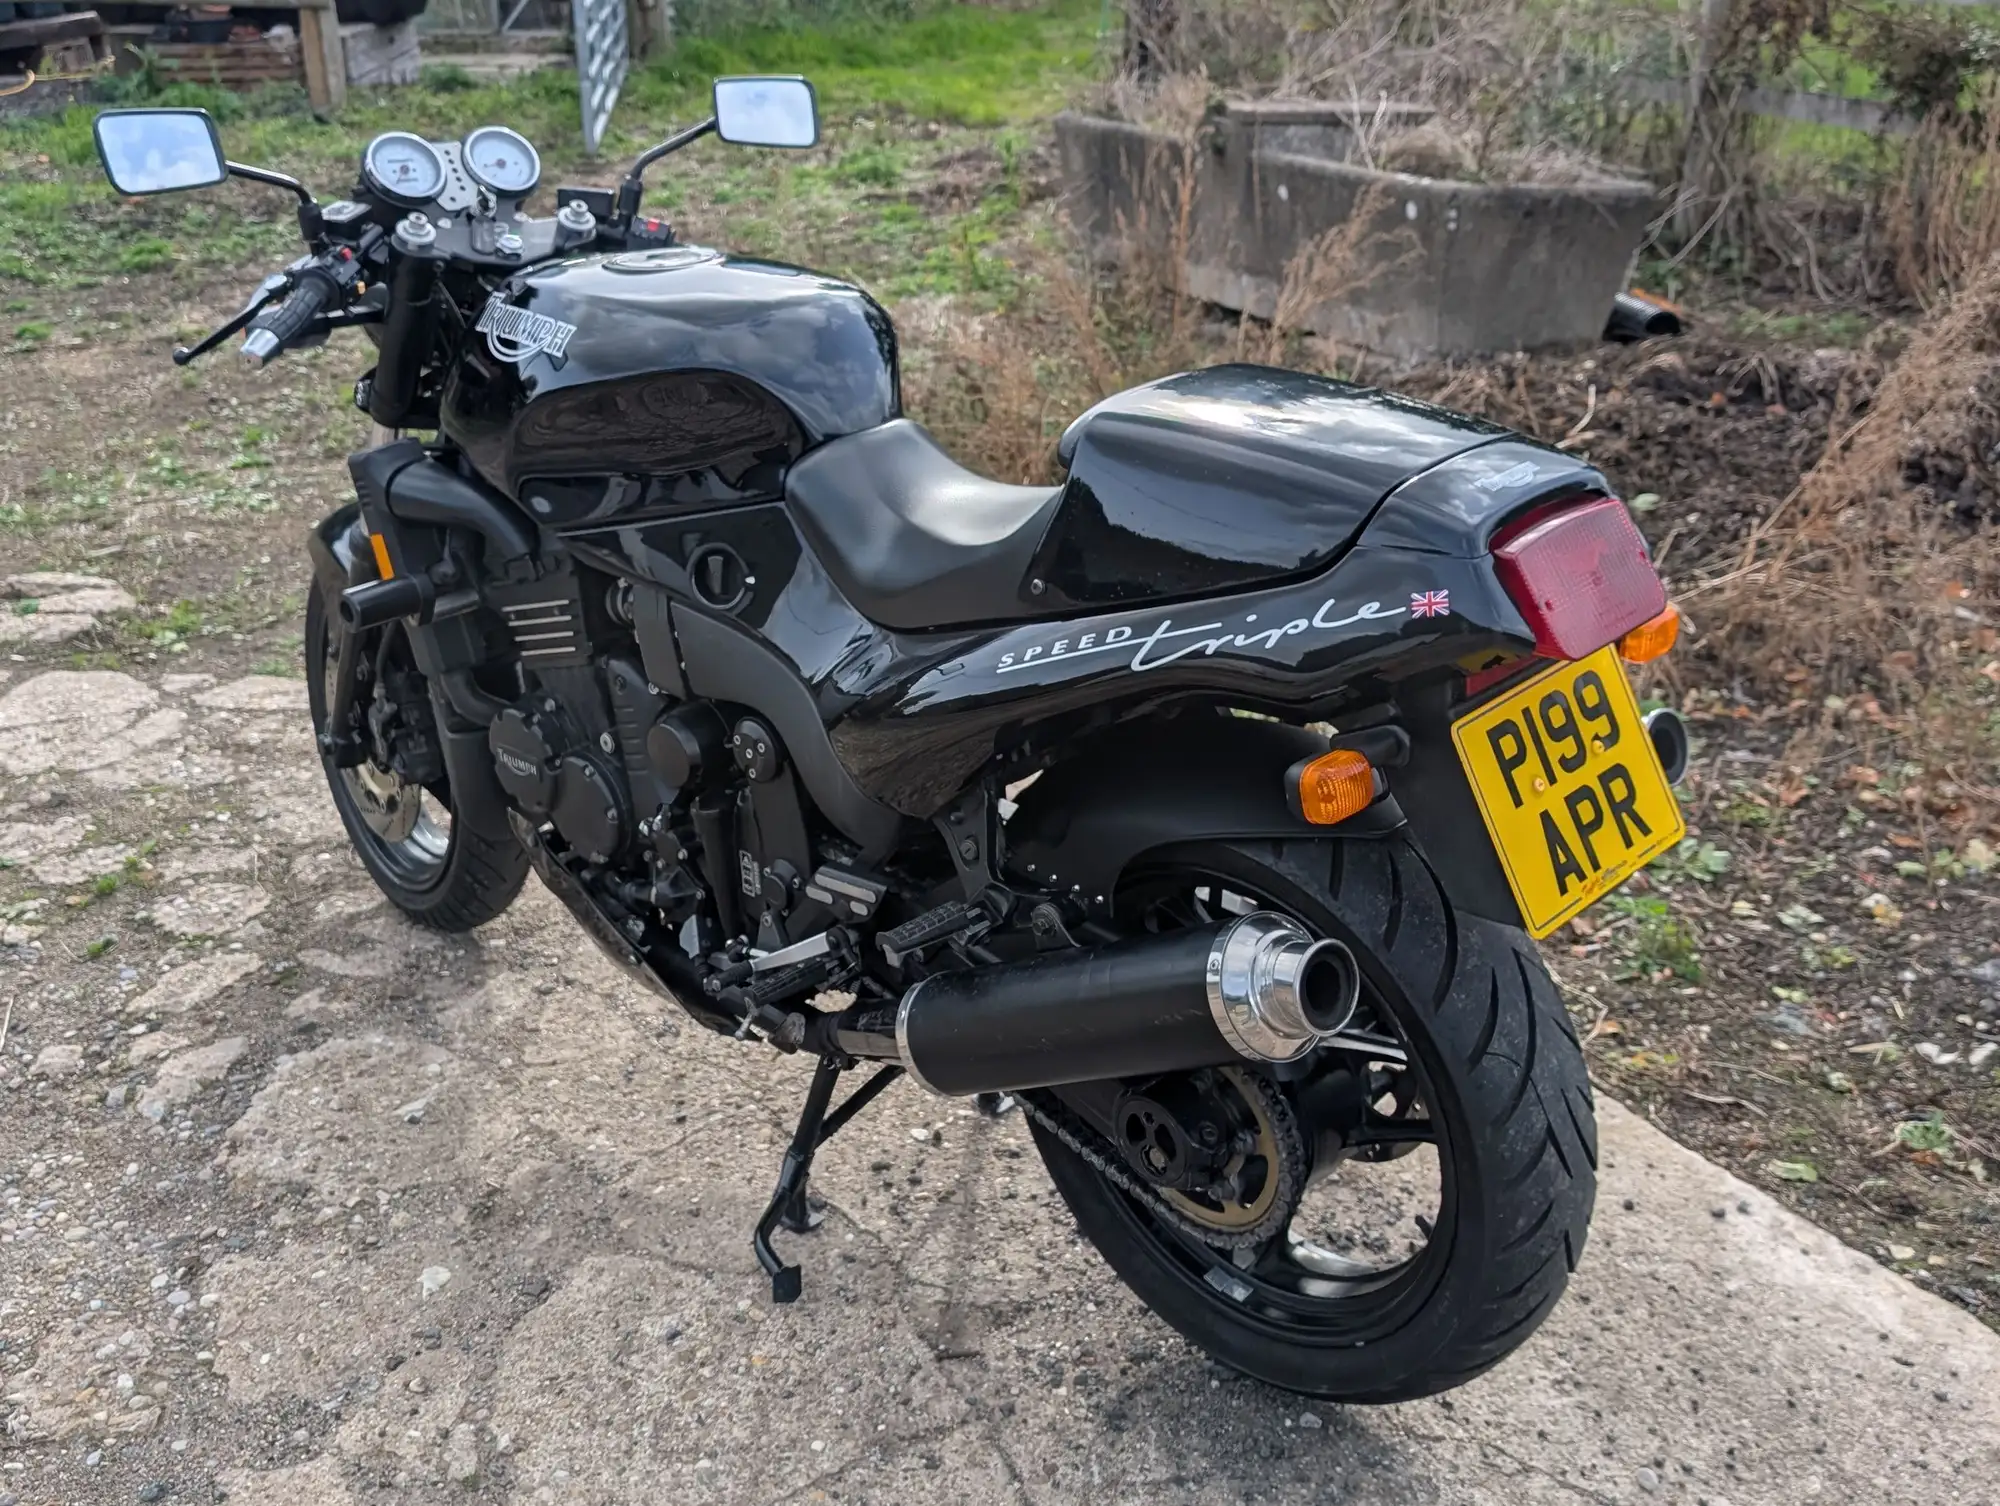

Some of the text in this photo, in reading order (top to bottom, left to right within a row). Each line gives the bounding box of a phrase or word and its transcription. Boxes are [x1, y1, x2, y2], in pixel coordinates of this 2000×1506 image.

[475, 291, 578, 360] TRIUMPH
[1000, 598, 1407, 672] SPEED triple
[497, 747, 538, 777] TRIUMPH
[1486, 669, 1620, 809] P199
[1539, 763, 1653, 897] APR
